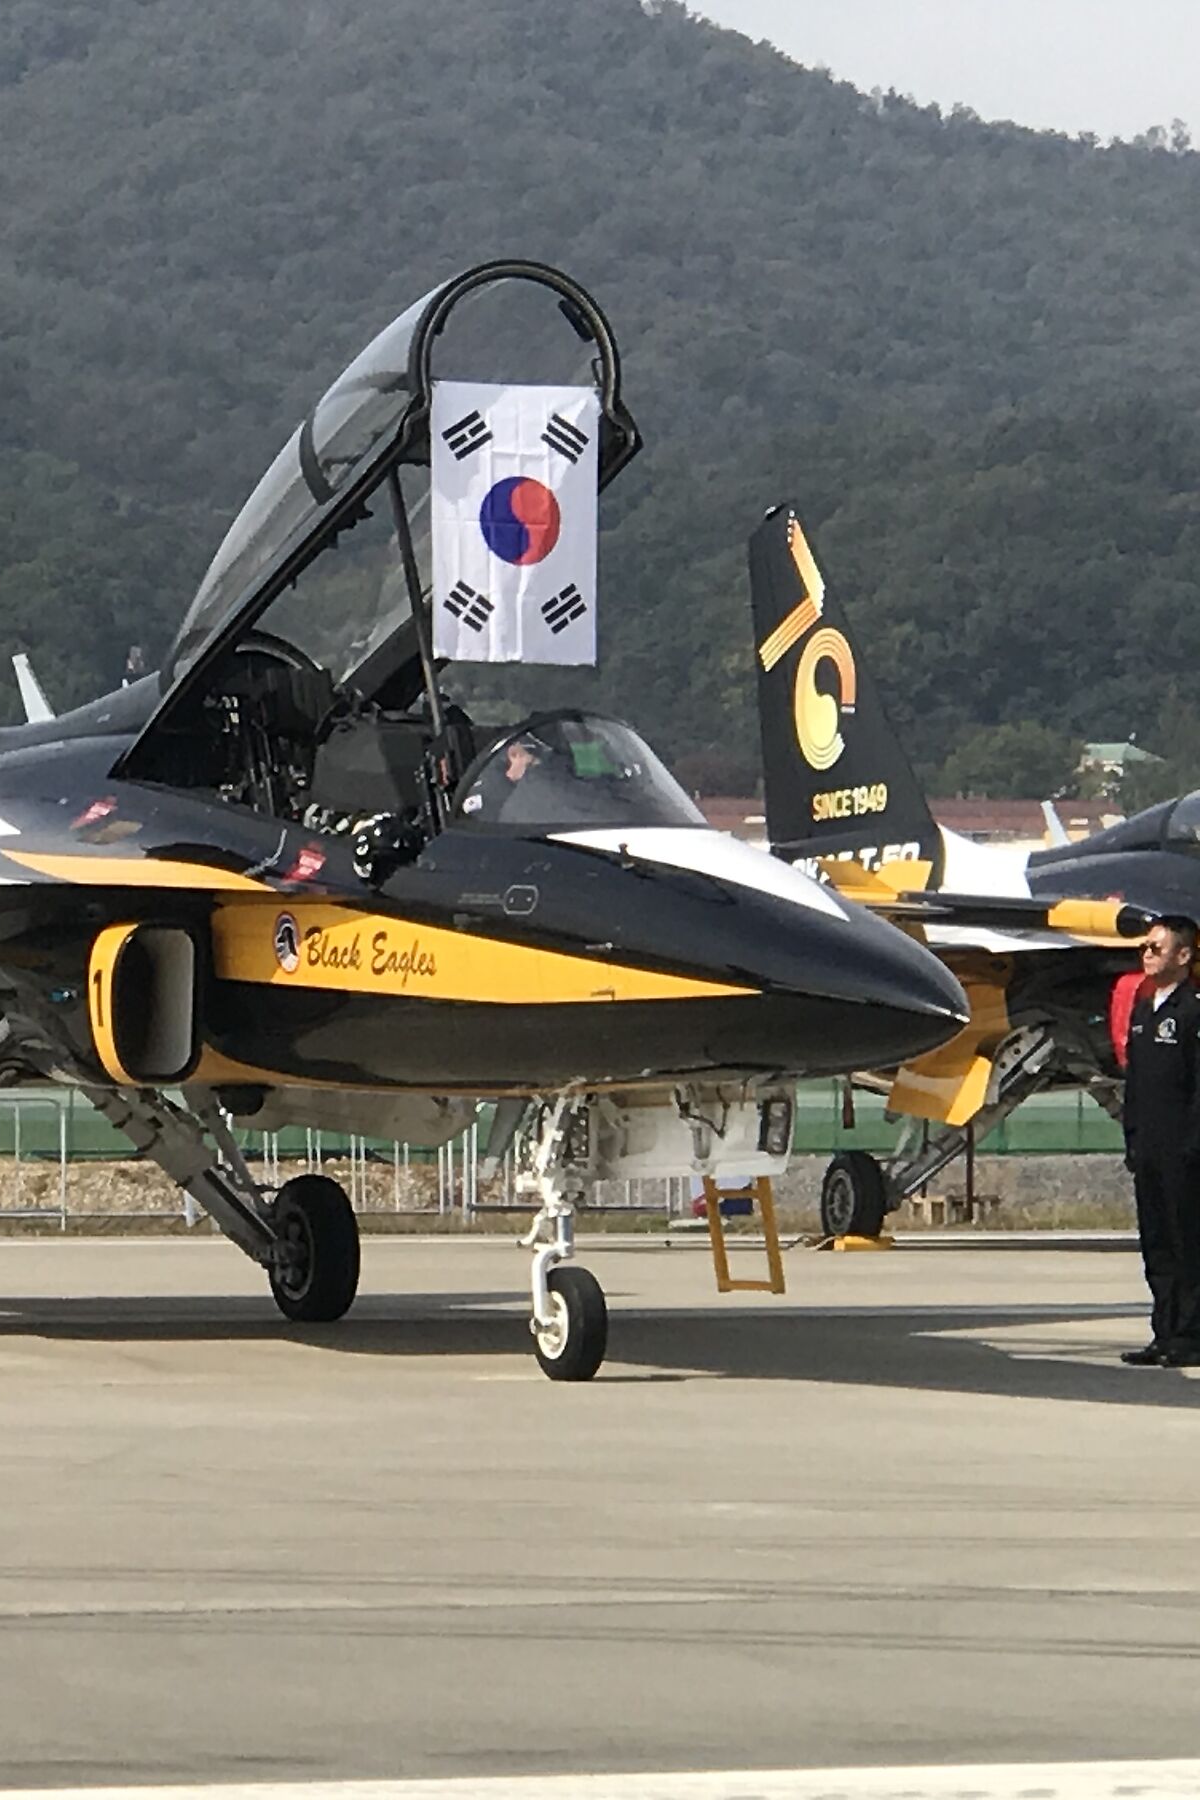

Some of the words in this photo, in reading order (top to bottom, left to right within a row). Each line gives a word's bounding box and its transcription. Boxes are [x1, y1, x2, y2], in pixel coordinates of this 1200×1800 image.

[812, 789, 852, 822] SINCE
[852, 783, 888, 815] 1949
[304, 926, 362, 971] Black
[371, 931, 437, 988] Eagles
[93, 968, 104, 1028] 1
